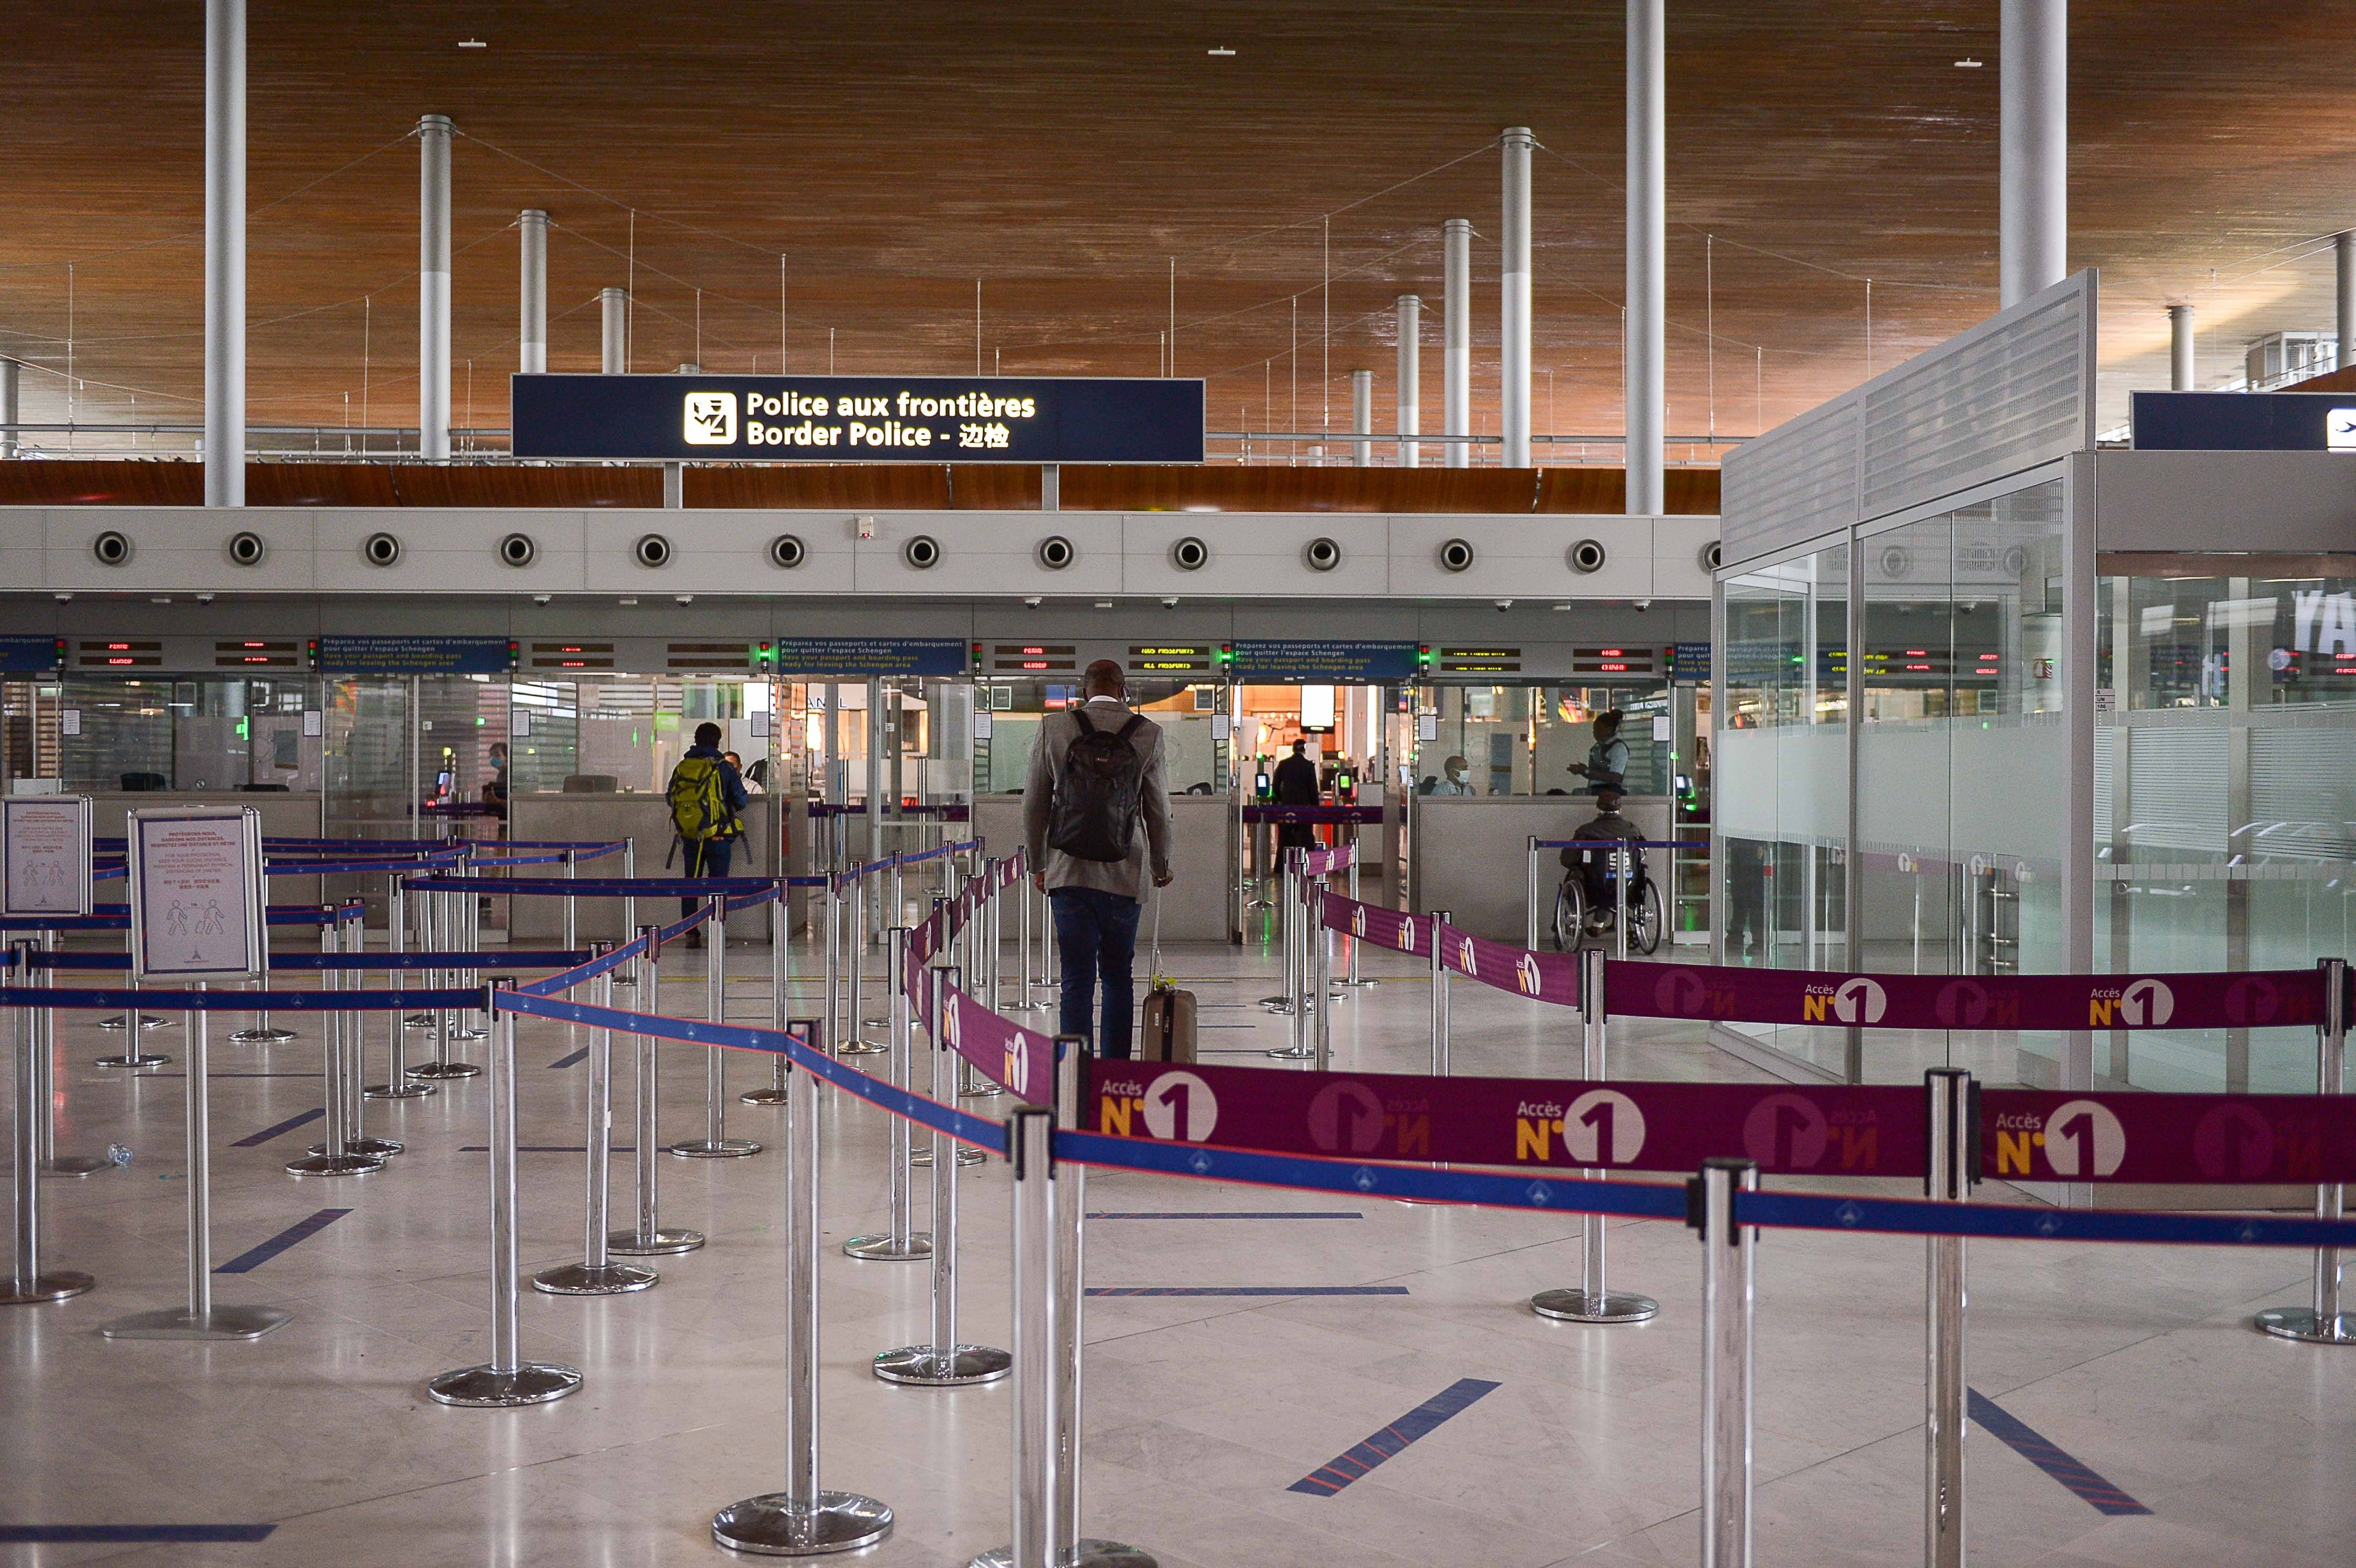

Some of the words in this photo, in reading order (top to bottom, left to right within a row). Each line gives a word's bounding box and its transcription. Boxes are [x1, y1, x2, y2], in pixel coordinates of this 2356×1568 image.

[747, 392, 829, 416] Police
[837, 398, 890, 417] aux
[897, 392, 1036, 418] frontières
[747, 420, 842, 446] Border
[850, 421, 932, 446] Police
[959, 422, 1009, 448] 边检
[1805, 984, 1834, 995] Accès
[2091, 988, 2119, 998] Accès
[1102, 1080, 1143, 1096] Accès
[1517, 1100, 1562, 1117] Accès
[1996, 1113, 2041, 1129] Accès
